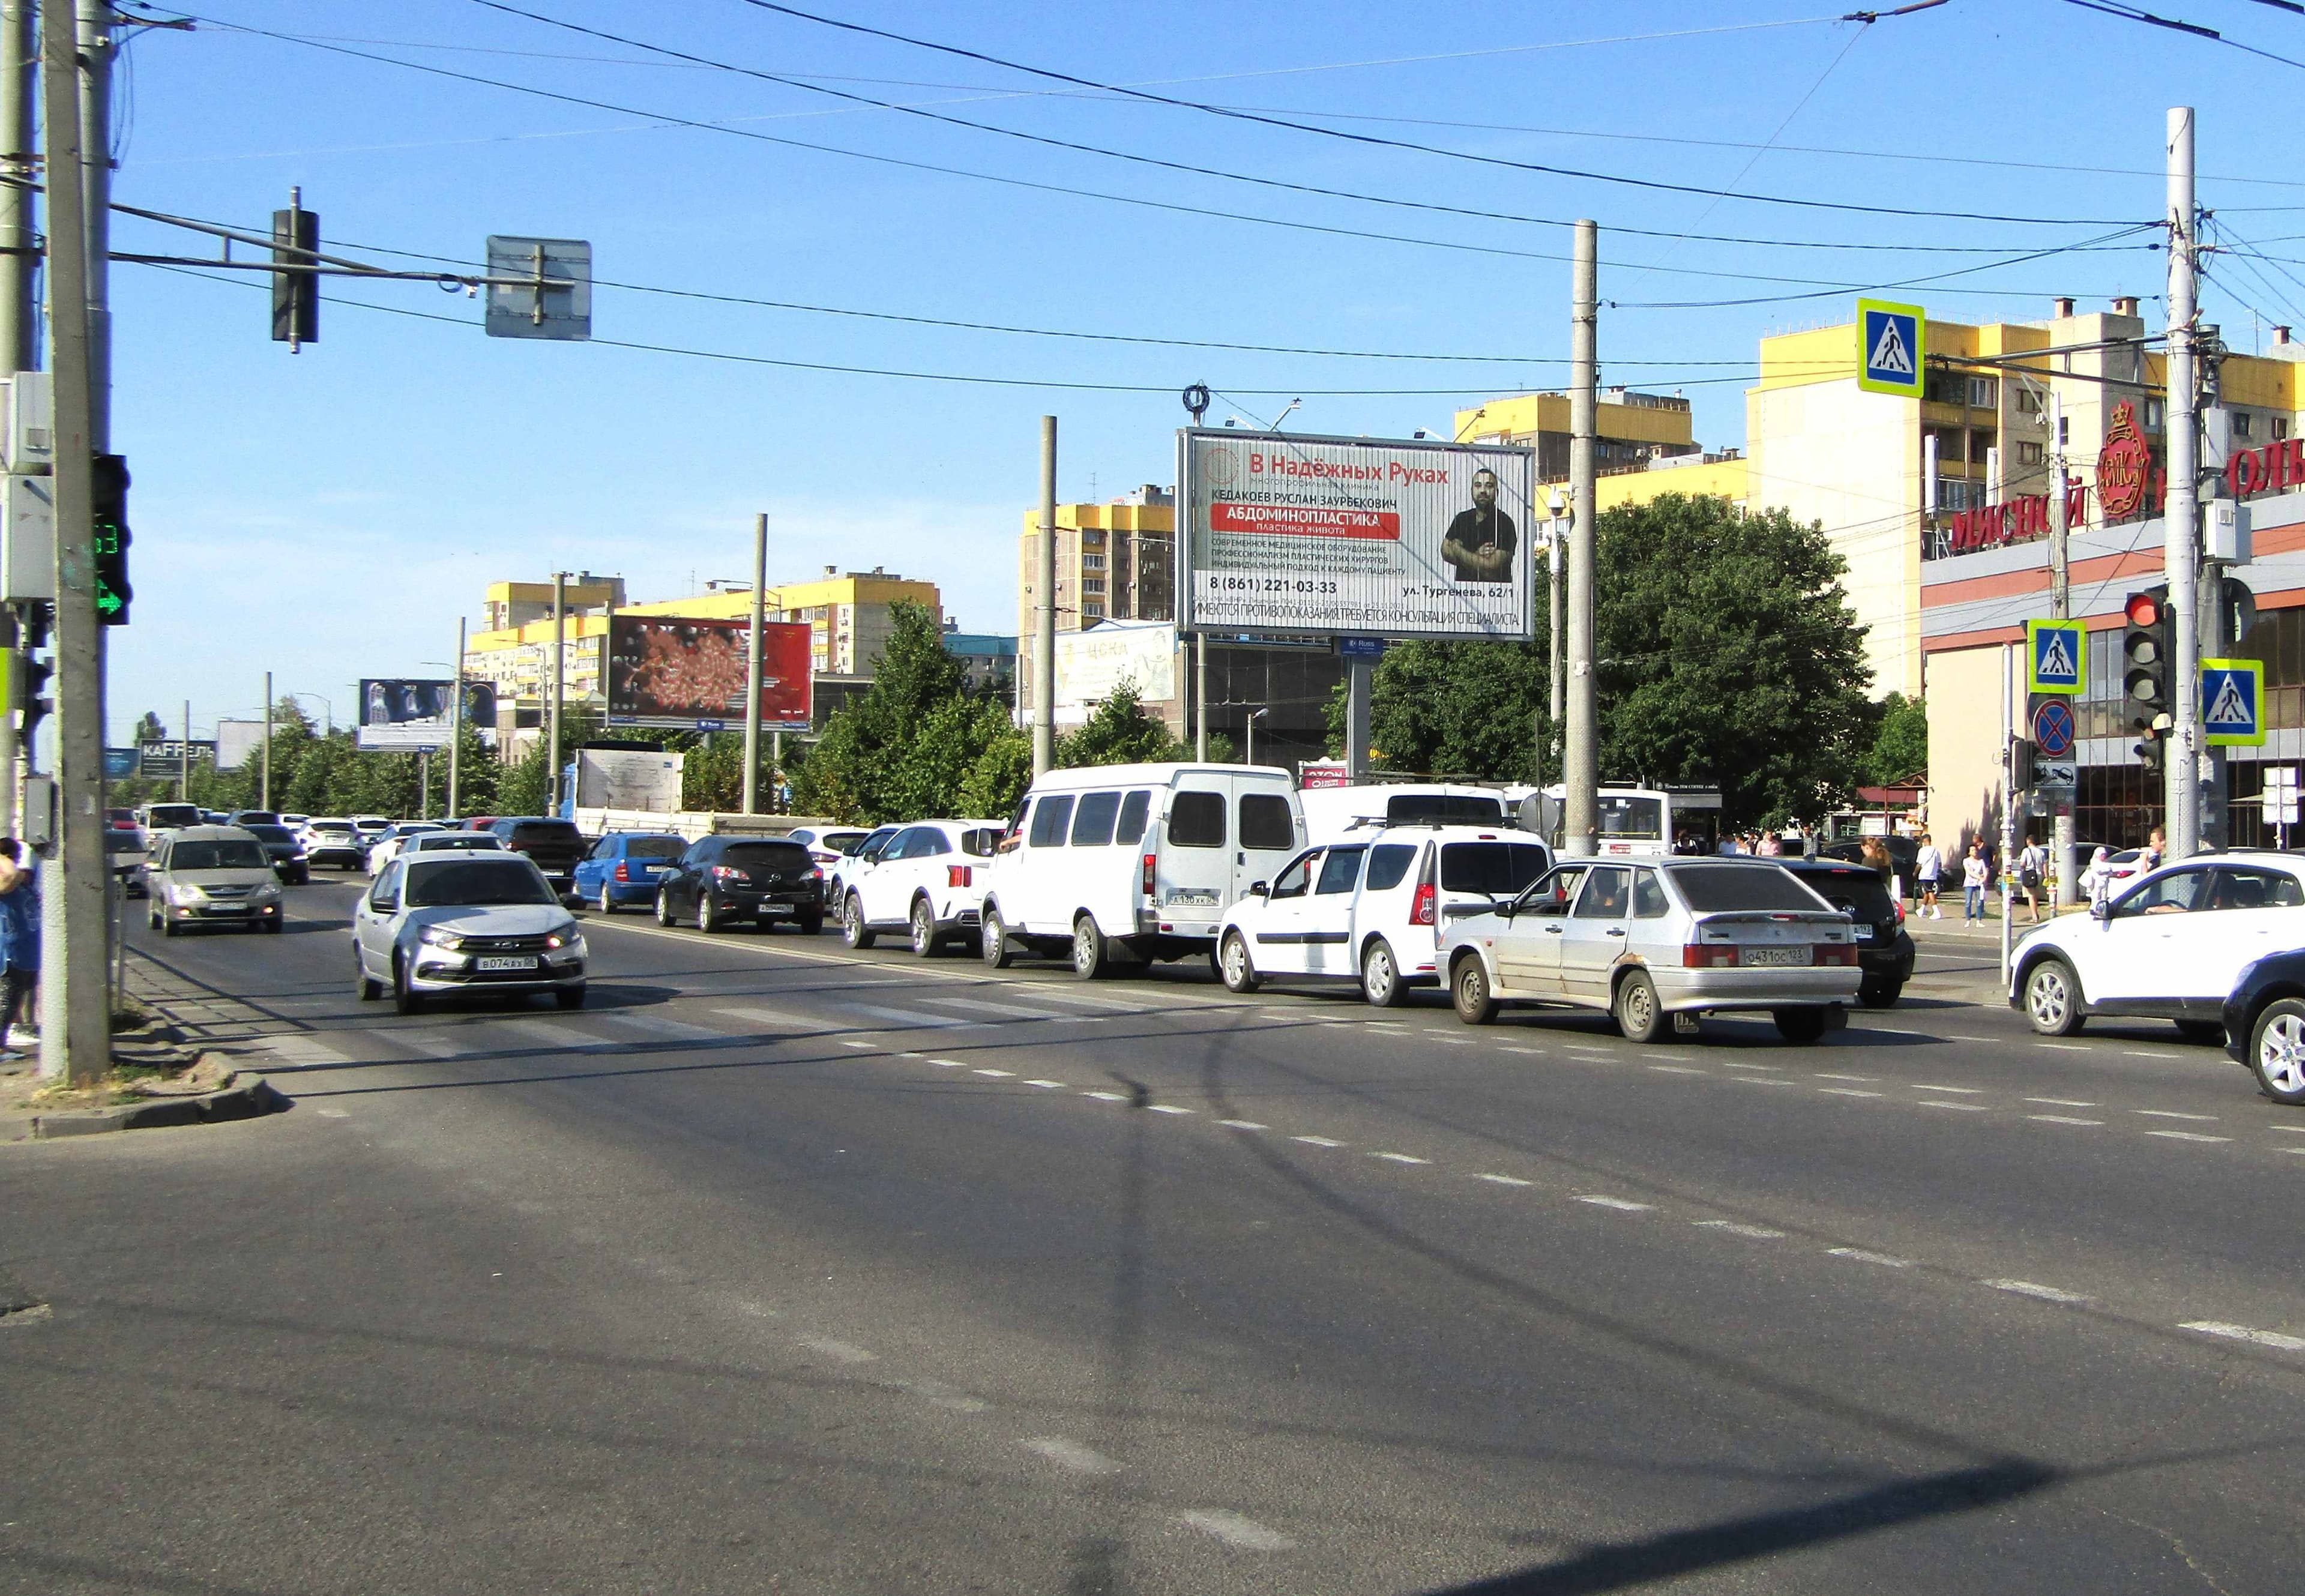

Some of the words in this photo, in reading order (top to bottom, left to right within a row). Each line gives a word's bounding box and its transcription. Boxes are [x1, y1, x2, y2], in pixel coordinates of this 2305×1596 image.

[1250, 453, 1264, 473] В
[1271, 455, 1383, 481] Надёжных
[1390, 462, 1448, 487] Руках
[1251, 478, 1337, 489] многопрофильная
[1212, 489, 1271, 502] КЕДАКОЕВ
[1274, 492, 1317, 505] РУСЛАН
[1320, 495, 1397, 509] ЗАУРБЕКОВИЧ
[1227, 507, 1380, 527] АБДОМИНОПЛАСТИКА
[1256, 522, 1303, 533] пластика
[1307, 526, 1345, 535] живота
[1212, 538, 1267, 548] СОВРЕМЕННОЕ
[1269, 541, 1325, 551] МЕДИЦИНСКОЕ
[1328, 544, 1387, 554] ОБОРУДОВАНИЕ
[1212, 549, 1289, 559] ПРОФЕССИОНАЛИЗМ
[1291, 552, 1349, 562] ПЛАСТИЧЕСКИХ
[1351, 556, 1388, 564] ХИРУРГОВ
[1212, 560, 1285, 570] ИНДИВИДУАЛЬНЫЙ
[1287, 563, 1319, 572] ПОДХОД
[1328, 565, 1366, 574] КАЖДОМУ
[1367, 567, 1406, 576] ПАЦИЕНТУ
[1210, 576, 1218, 589] 8
[1222, 577, 1260, 592] (861)
[1264, 579, 1337, 594] 221-03-33
[1403, 586, 1420, 597] ул.
[1422, 585, 1485, 598] Тургенева,
[1489, 588, 1513, 598] 62/1
[1193, 602, 1238, 616] ИМЕЮТСЯ
[1340, 608, 1387, 621] ТРЕБУЕТСЯ
[1389, 609, 1455, 624] КОНСУЛЬТАЦИЯ
